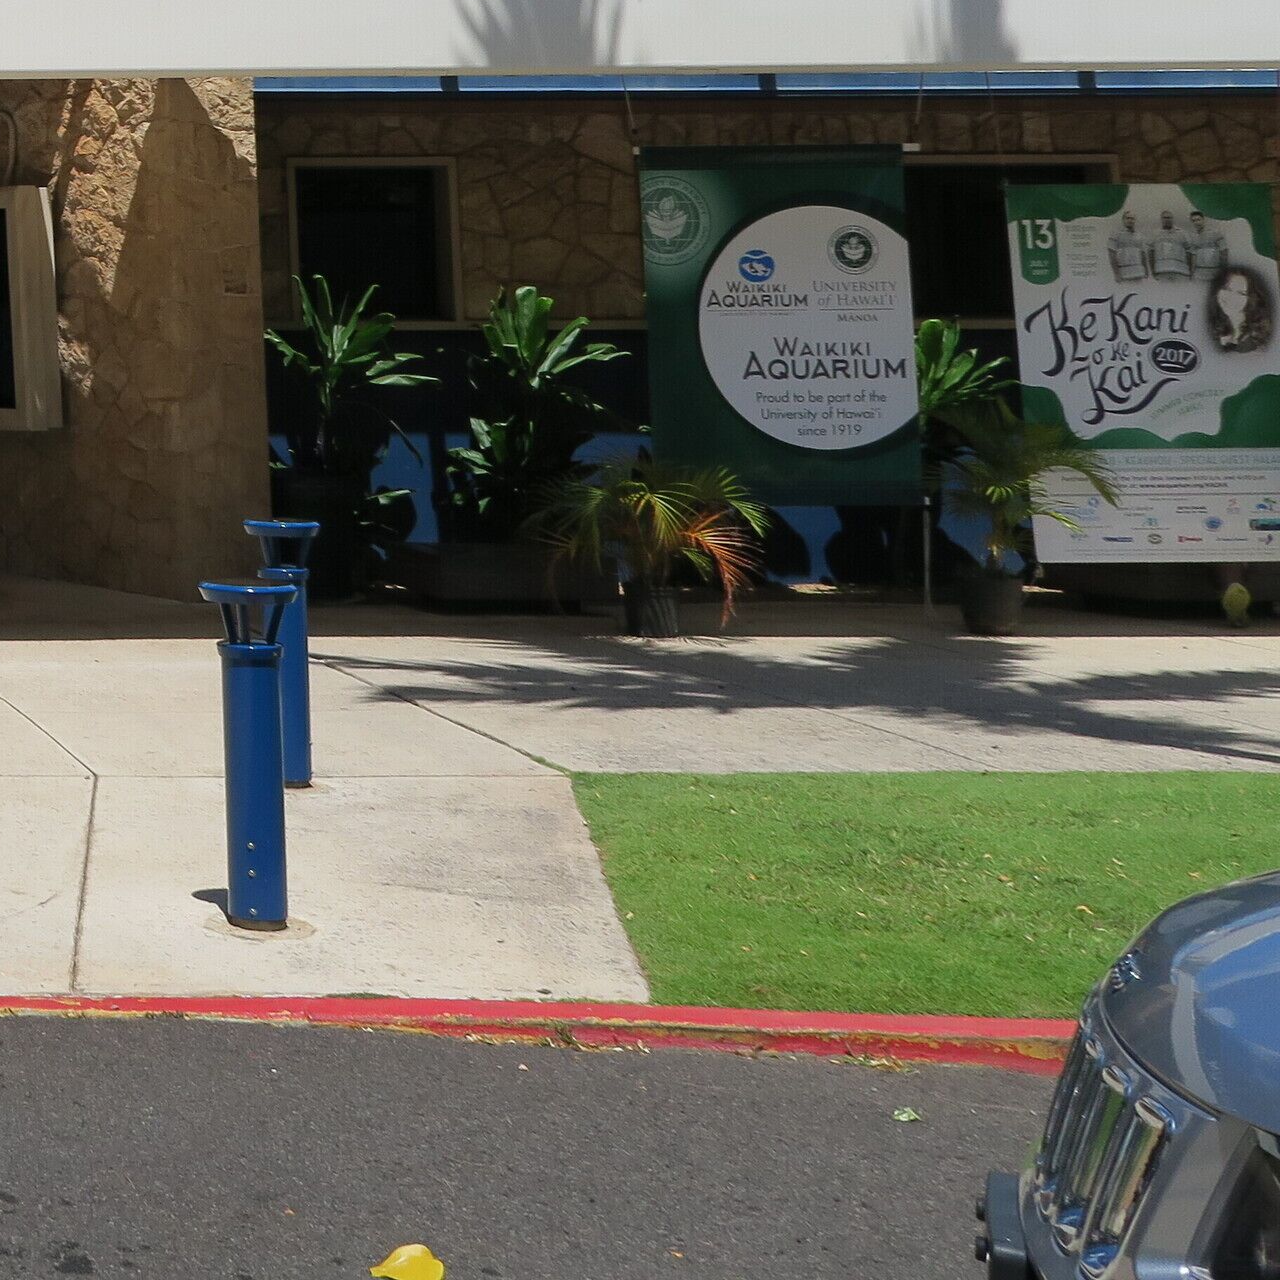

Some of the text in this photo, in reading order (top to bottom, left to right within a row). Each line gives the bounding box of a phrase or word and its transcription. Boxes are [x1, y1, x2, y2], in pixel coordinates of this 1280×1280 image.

[1021, 219, 1054, 249] 13
[812, 280, 897, 293] UNIVERSITY
[707, 290, 809, 308] AQUARIUM
[817, 294, 831, 307] of
[1080, 293, 1192, 345] Kani
[743, 350, 907, 380] AQUARIUM
[1154, 348, 1196, 365] 2017
[1070, 351, 1176, 425] Kai
[755, 389, 887, 405] Proud to be part of the
[760, 408, 817, 422] University
[822, 407, 835, 419] of
[797, 424, 863, 436] since 1919
